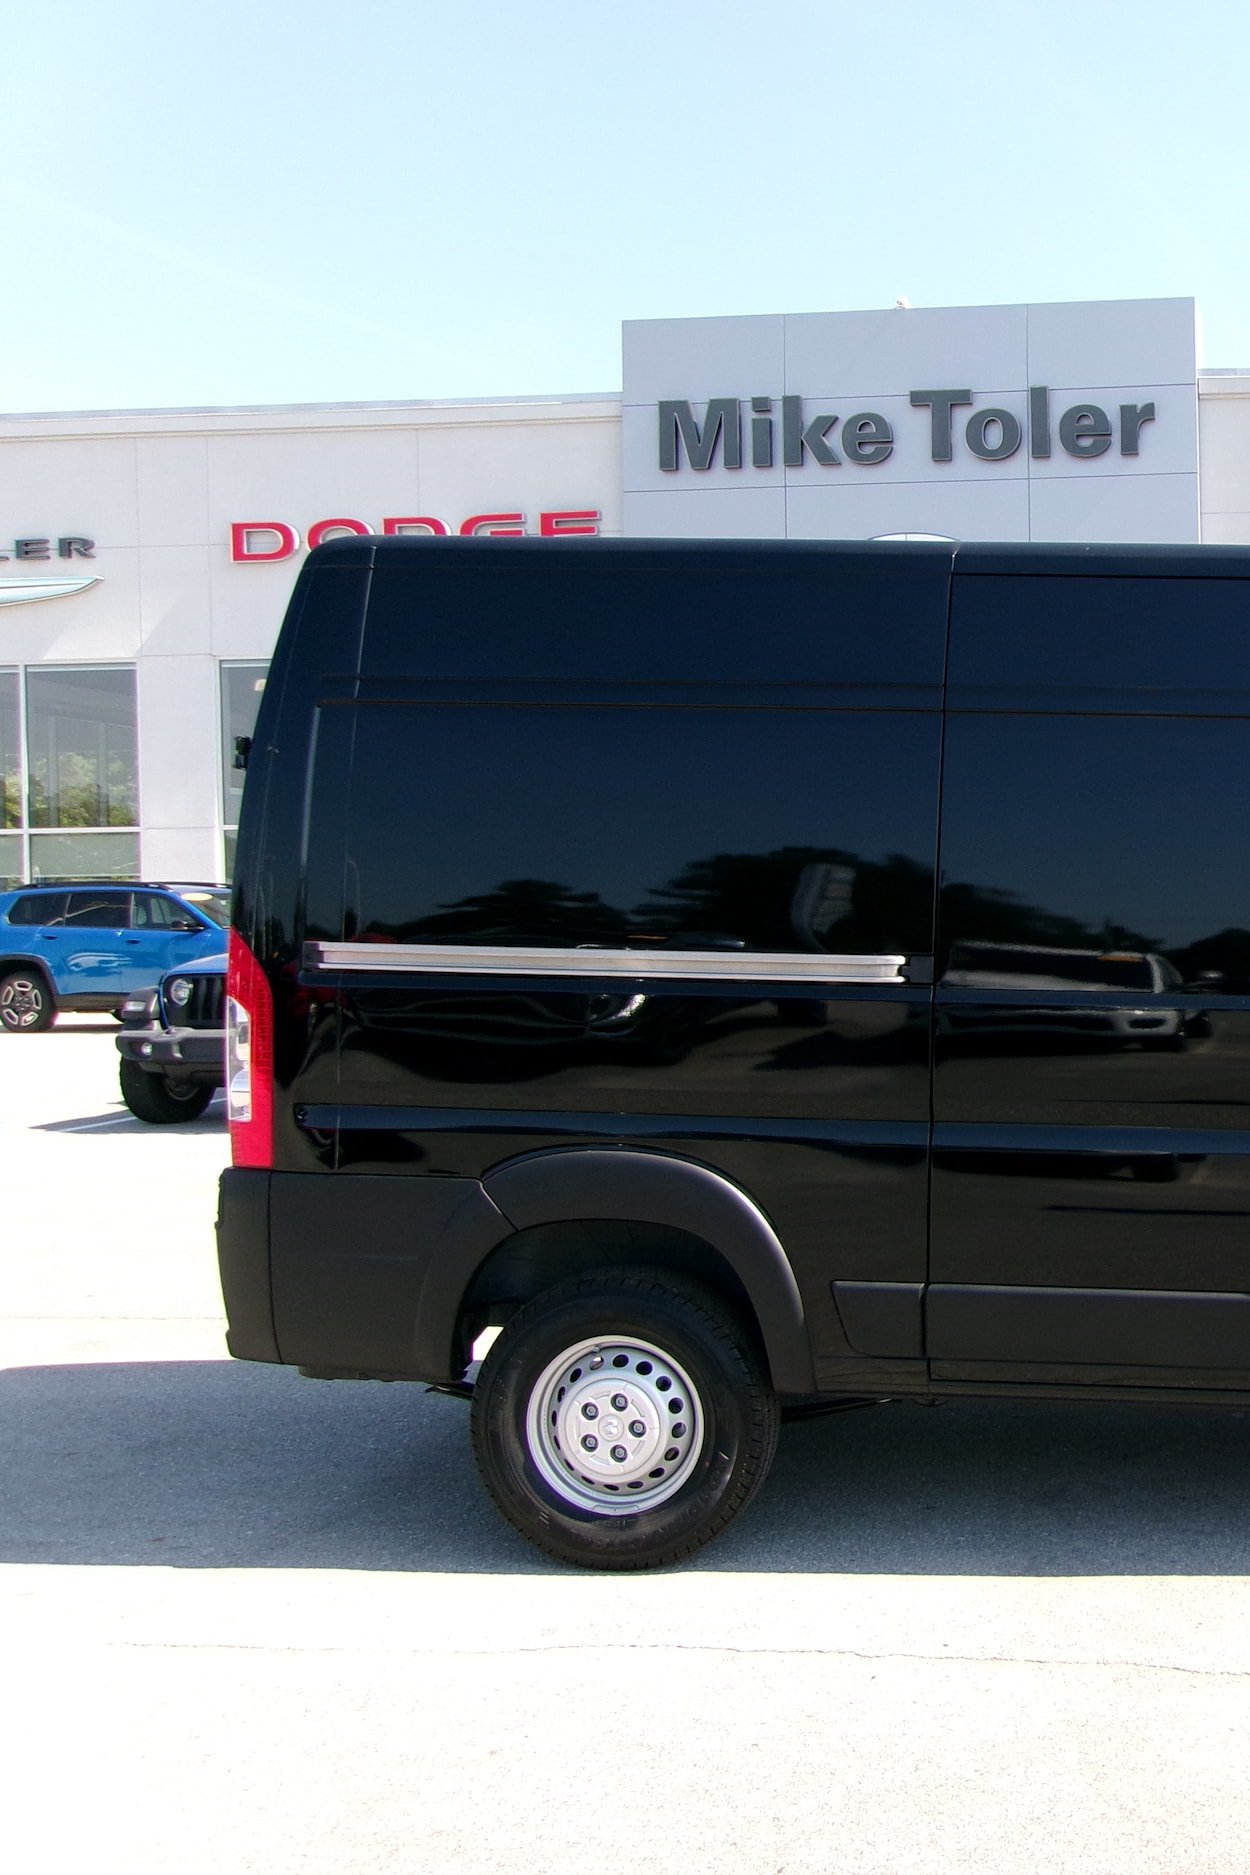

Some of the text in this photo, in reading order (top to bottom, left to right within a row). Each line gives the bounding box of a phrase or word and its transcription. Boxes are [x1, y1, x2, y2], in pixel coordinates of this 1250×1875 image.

[658, 385, 1155, 471] Mike Toler
[0, 537, 97, 560] ER
